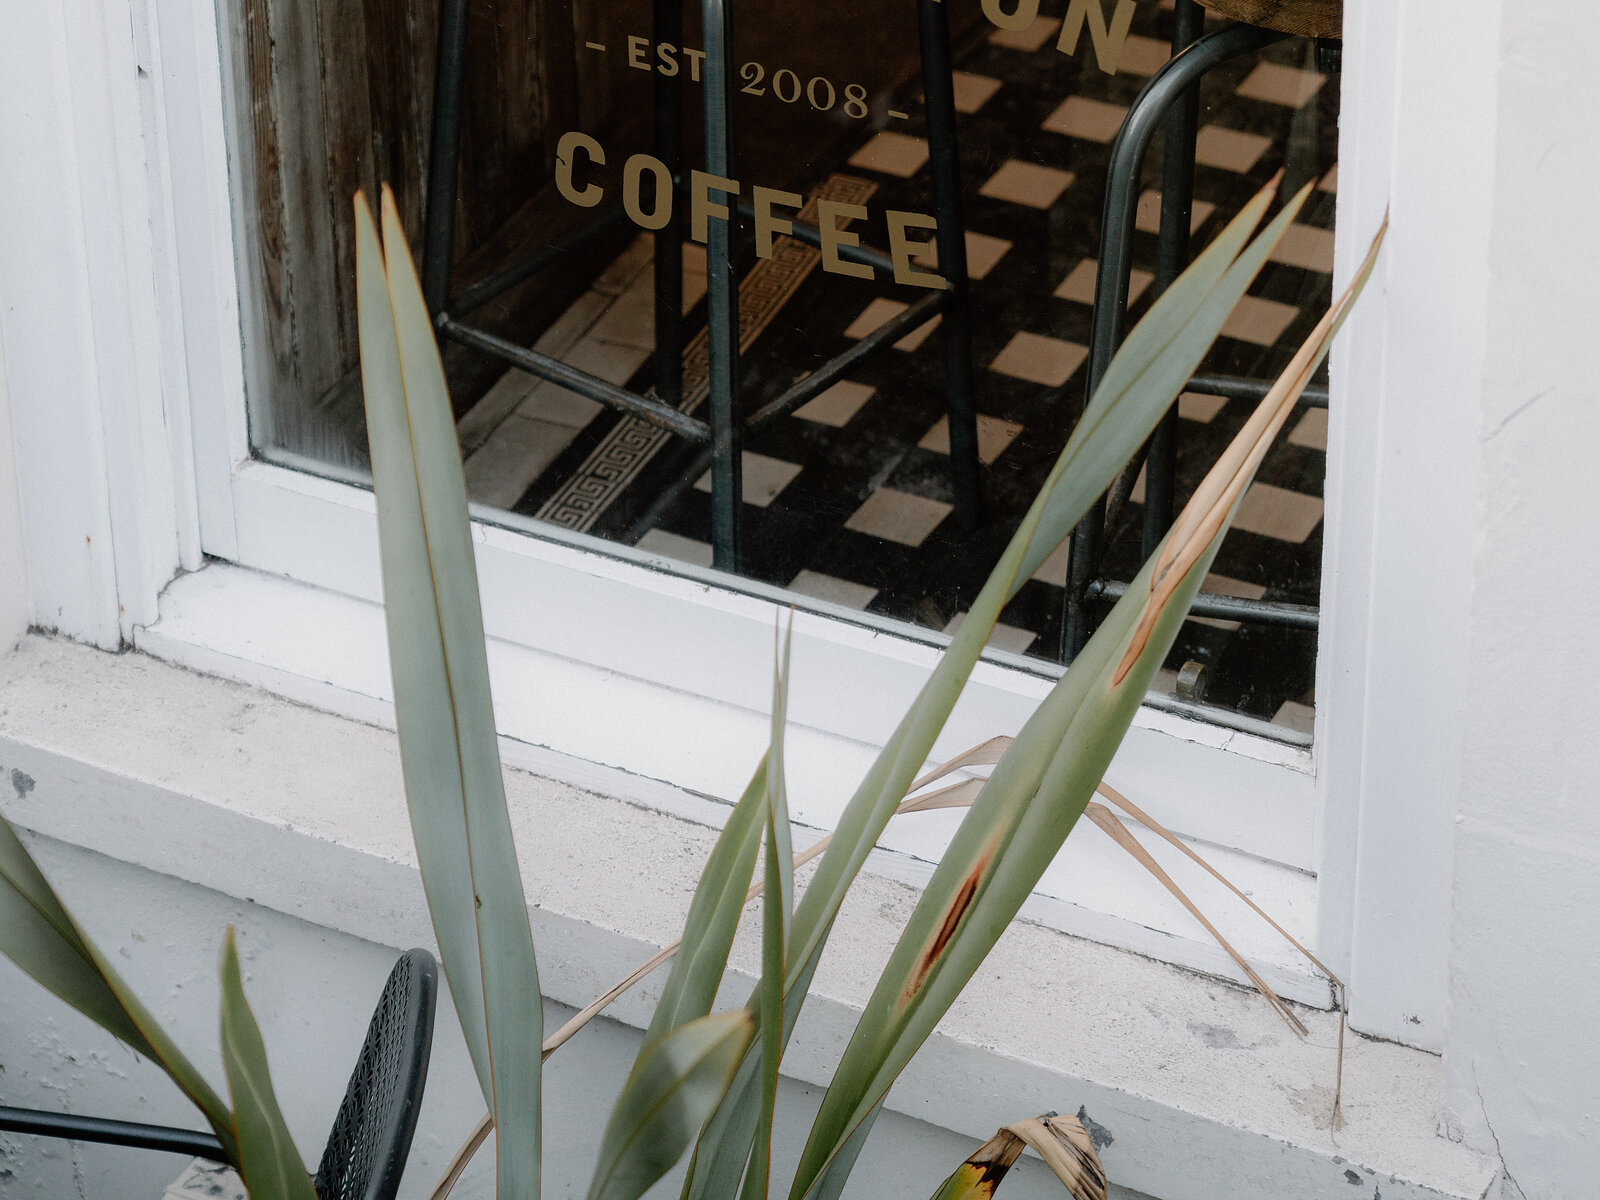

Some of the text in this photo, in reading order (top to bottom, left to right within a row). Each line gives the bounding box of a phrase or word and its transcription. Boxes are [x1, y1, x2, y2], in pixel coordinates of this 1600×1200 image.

[627, 35, 869, 119] EST 2008
[555, 131, 948, 290] COFFEE
